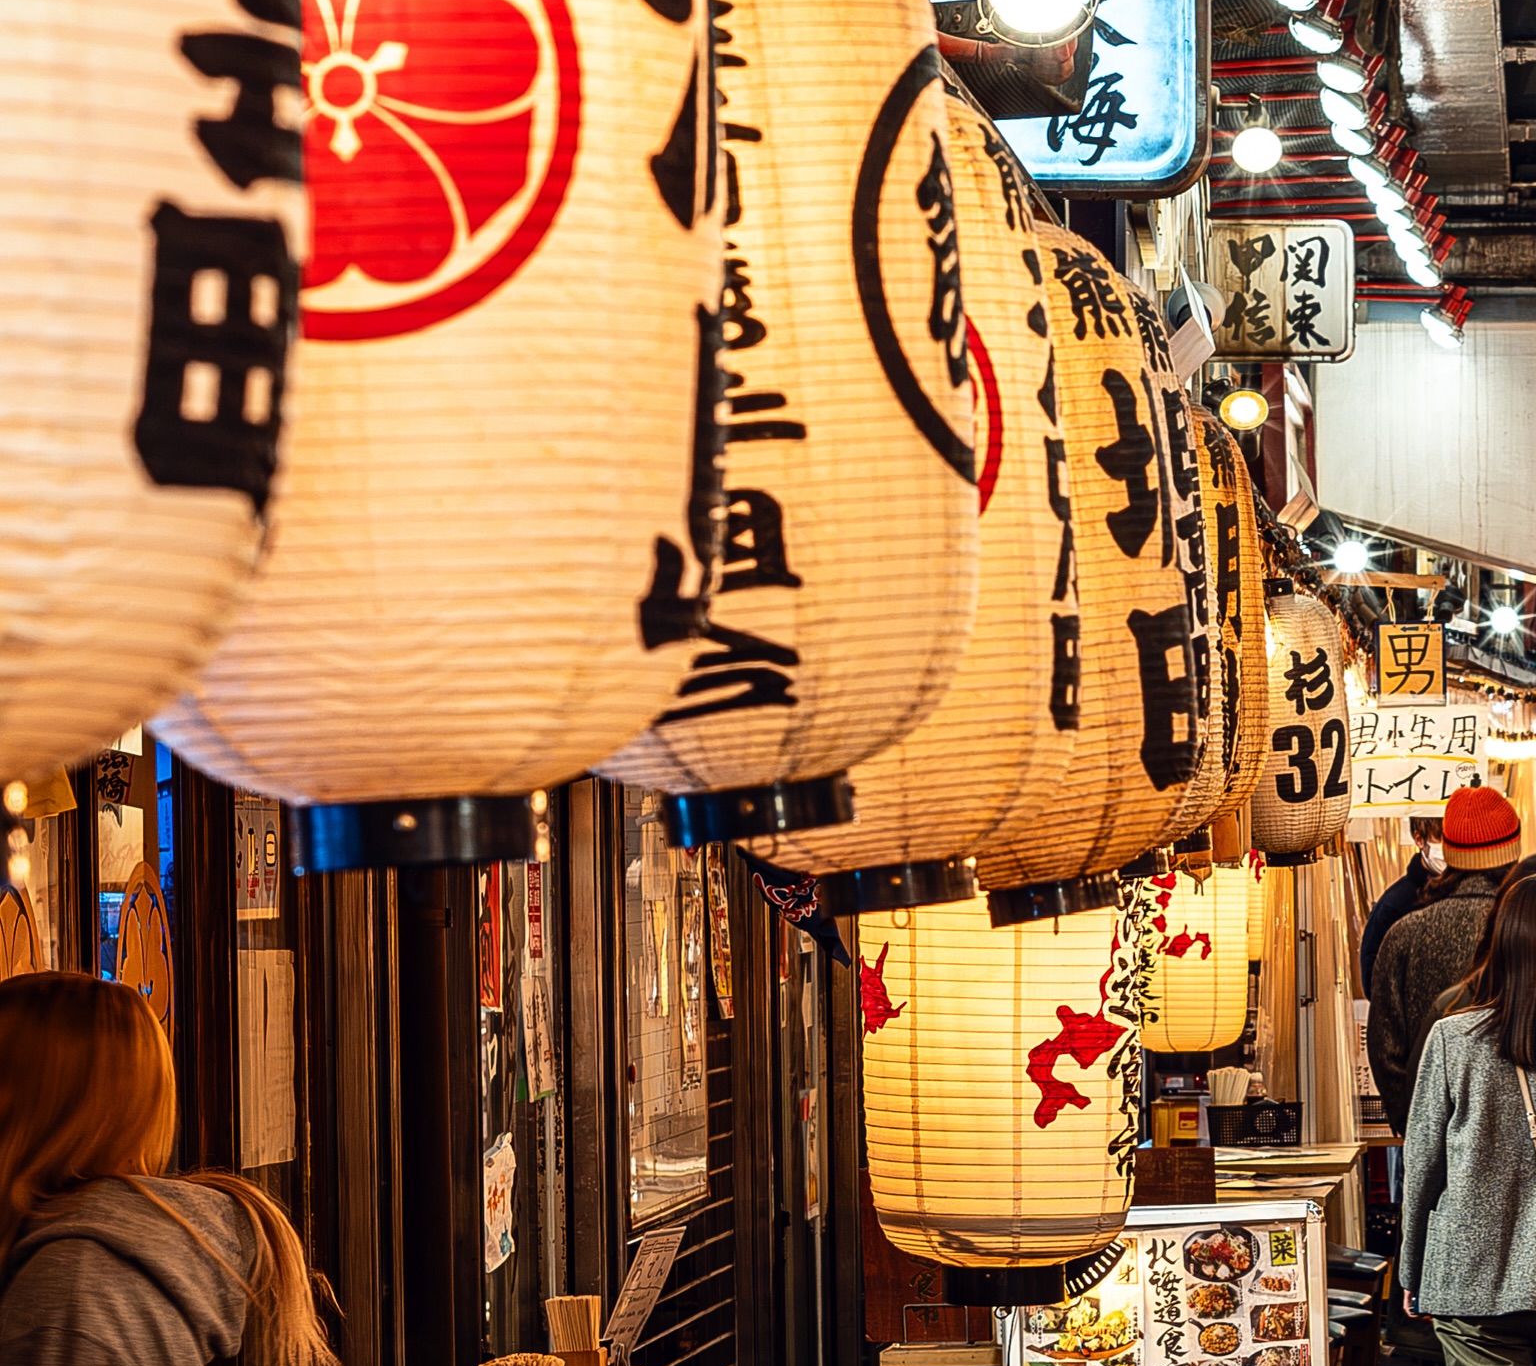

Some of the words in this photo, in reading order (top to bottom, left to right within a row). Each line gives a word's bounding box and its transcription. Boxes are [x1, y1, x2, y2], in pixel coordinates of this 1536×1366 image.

[1224, 235, 1276, 346] 甲信
[1279, 234, 1331, 348] 関東
[1284, 647, 1335, 716] 杉
[1385, 634, 1436, 696] 男
[1272, 718, 1349, 804] 32
[1272, 1235, 1297, 1262] 菜
